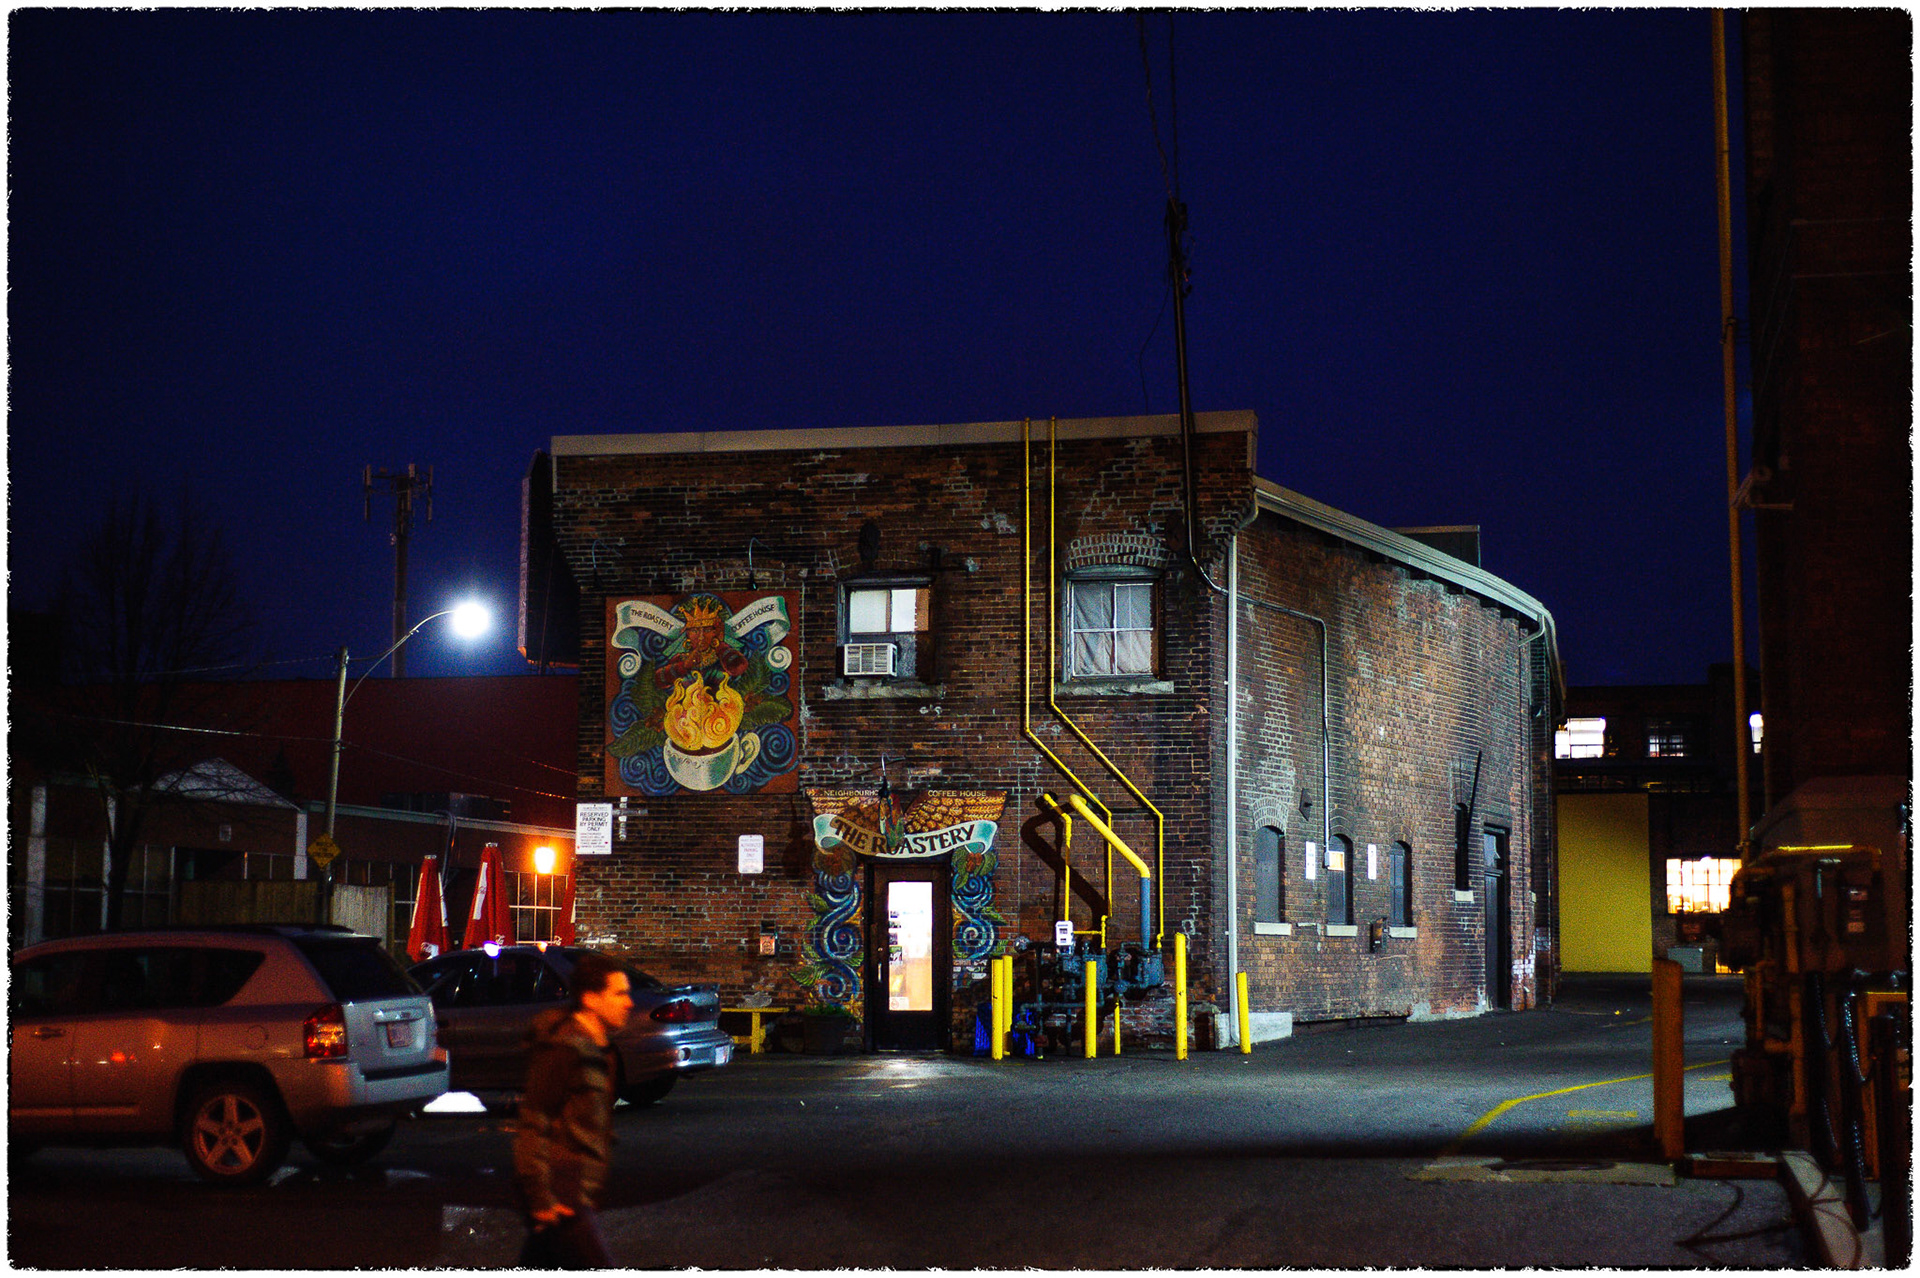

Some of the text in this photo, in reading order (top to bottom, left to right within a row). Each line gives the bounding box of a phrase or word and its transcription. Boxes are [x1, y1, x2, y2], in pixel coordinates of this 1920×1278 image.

[631, 608, 674, 630] THE ROASTERY
[927, 789, 957, 797] COFFEE
[959, 789, 986, 797] HOUSE
[834, 819, 868, 849] THE
